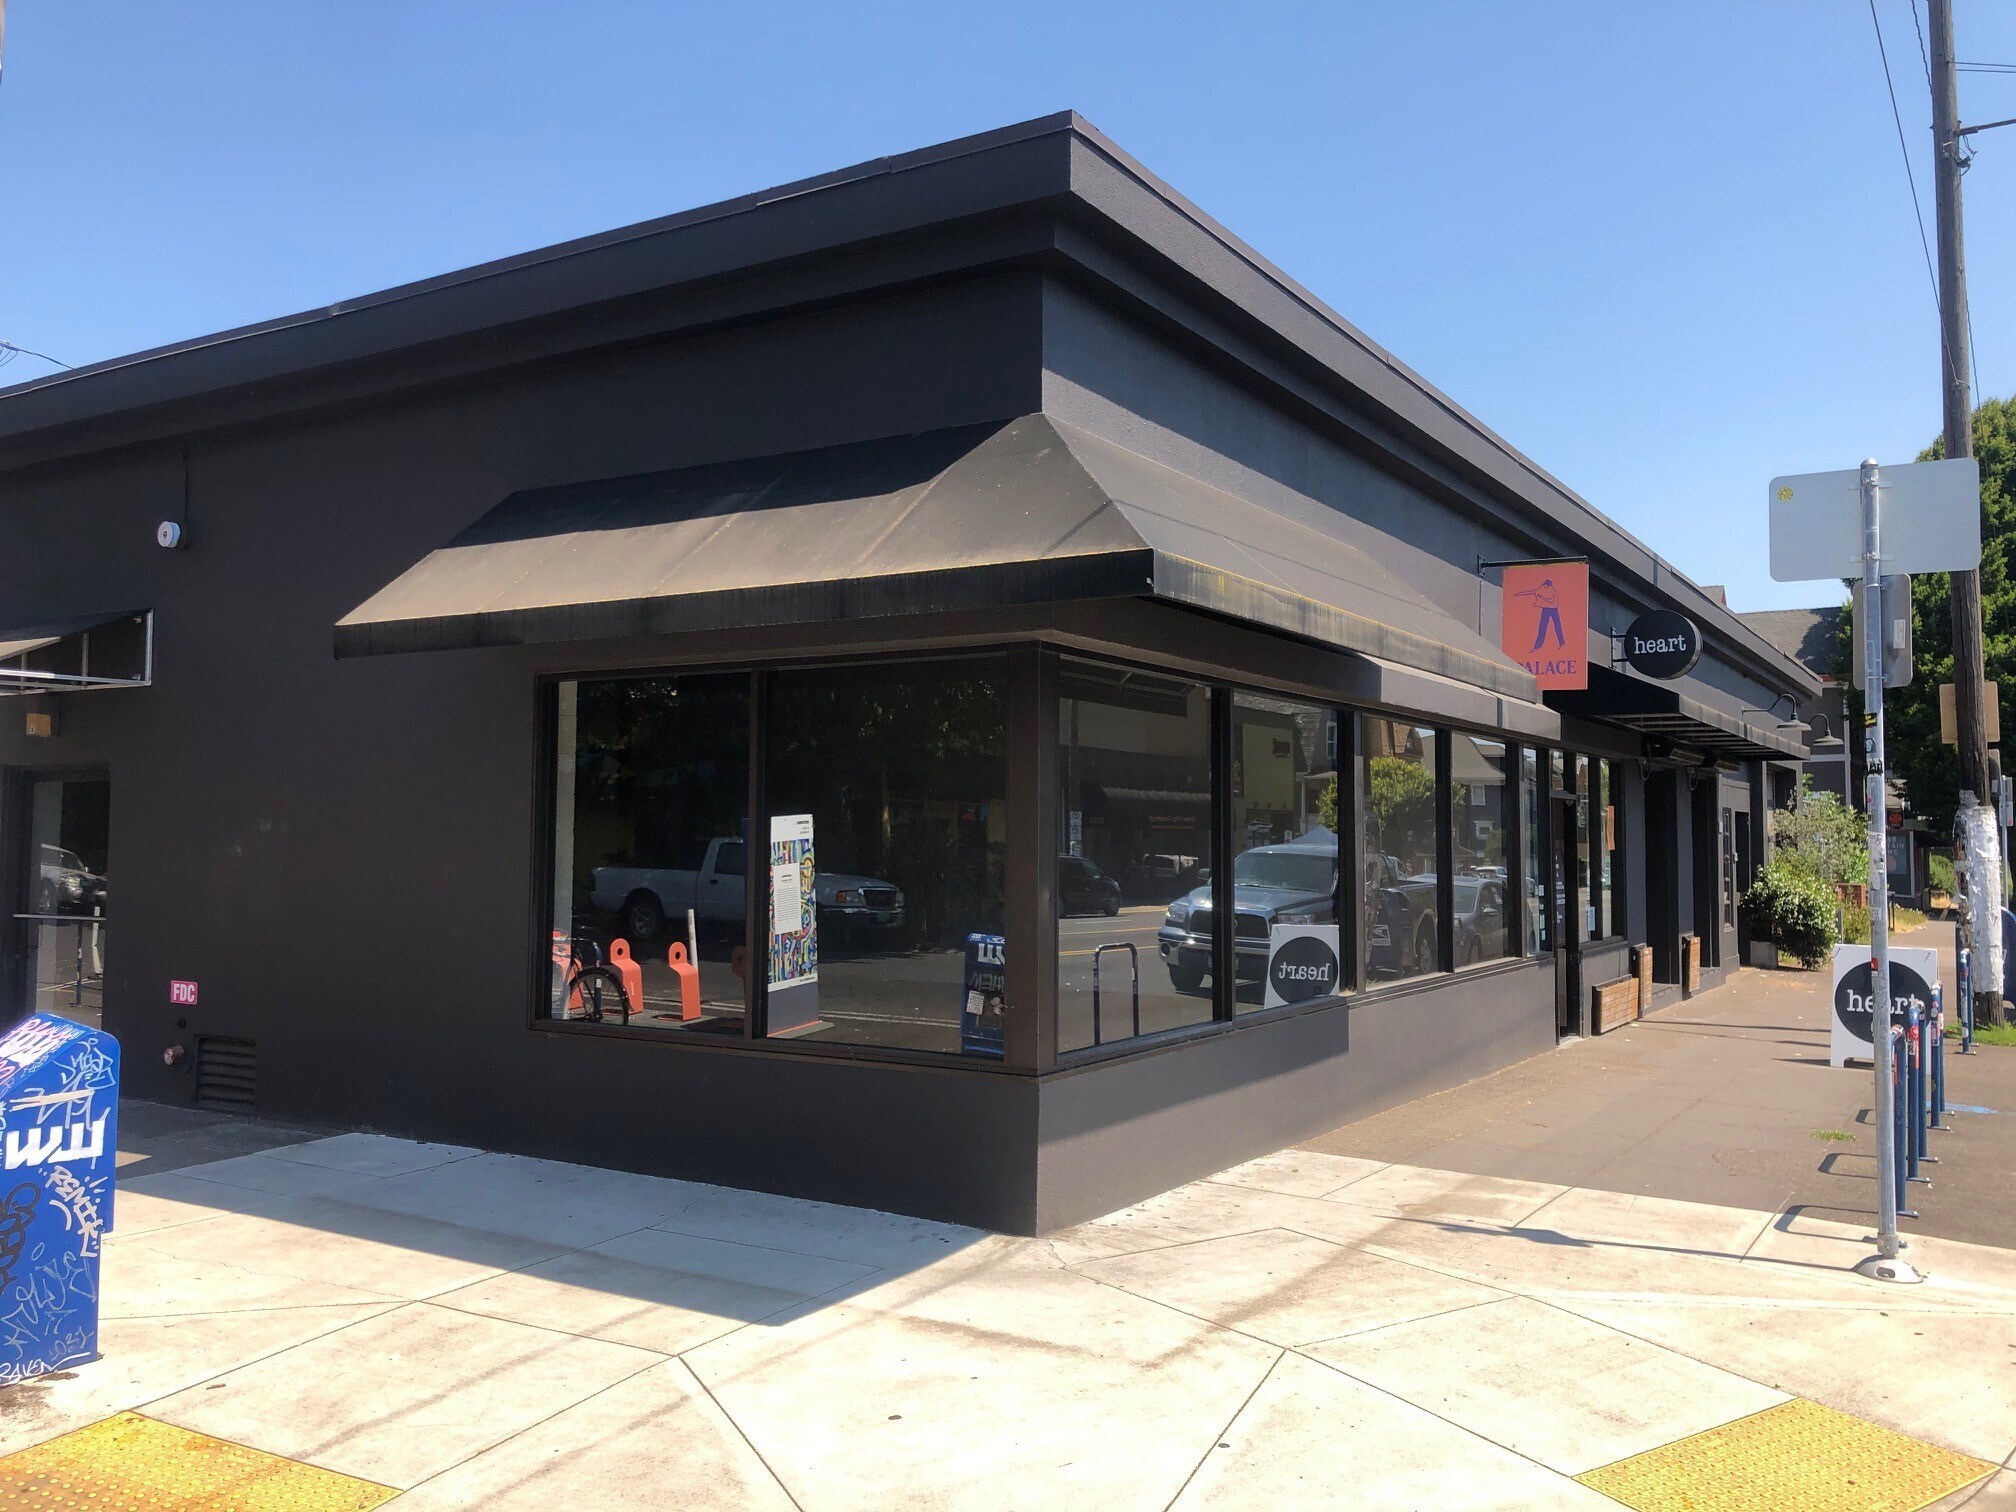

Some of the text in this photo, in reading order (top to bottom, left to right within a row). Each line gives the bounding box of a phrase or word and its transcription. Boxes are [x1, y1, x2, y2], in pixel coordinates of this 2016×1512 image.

[1634, 634, 1686, 654] heart
[173, 983, 195, 1003] FDC
[1846, 989, 1918, 1014] hert
